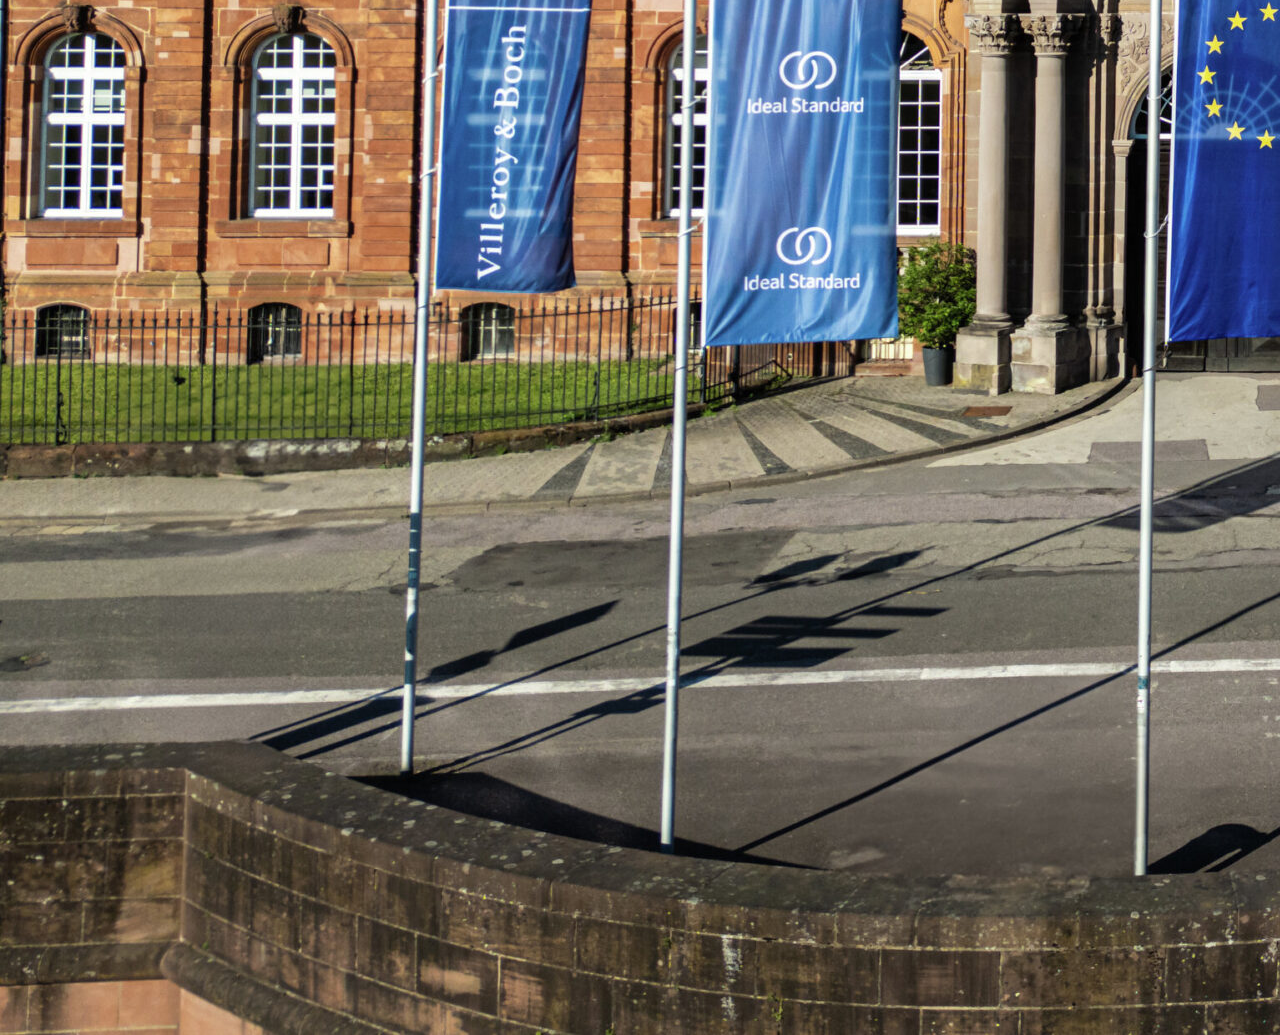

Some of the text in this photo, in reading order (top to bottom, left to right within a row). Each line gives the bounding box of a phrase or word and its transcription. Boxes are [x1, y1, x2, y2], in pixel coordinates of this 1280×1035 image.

[746, 96, 865, 115] Ideal Standard
[477, 24, 528, 280] Villeroy & Boch
[743, 271, 861, 292] Ideal Standard
